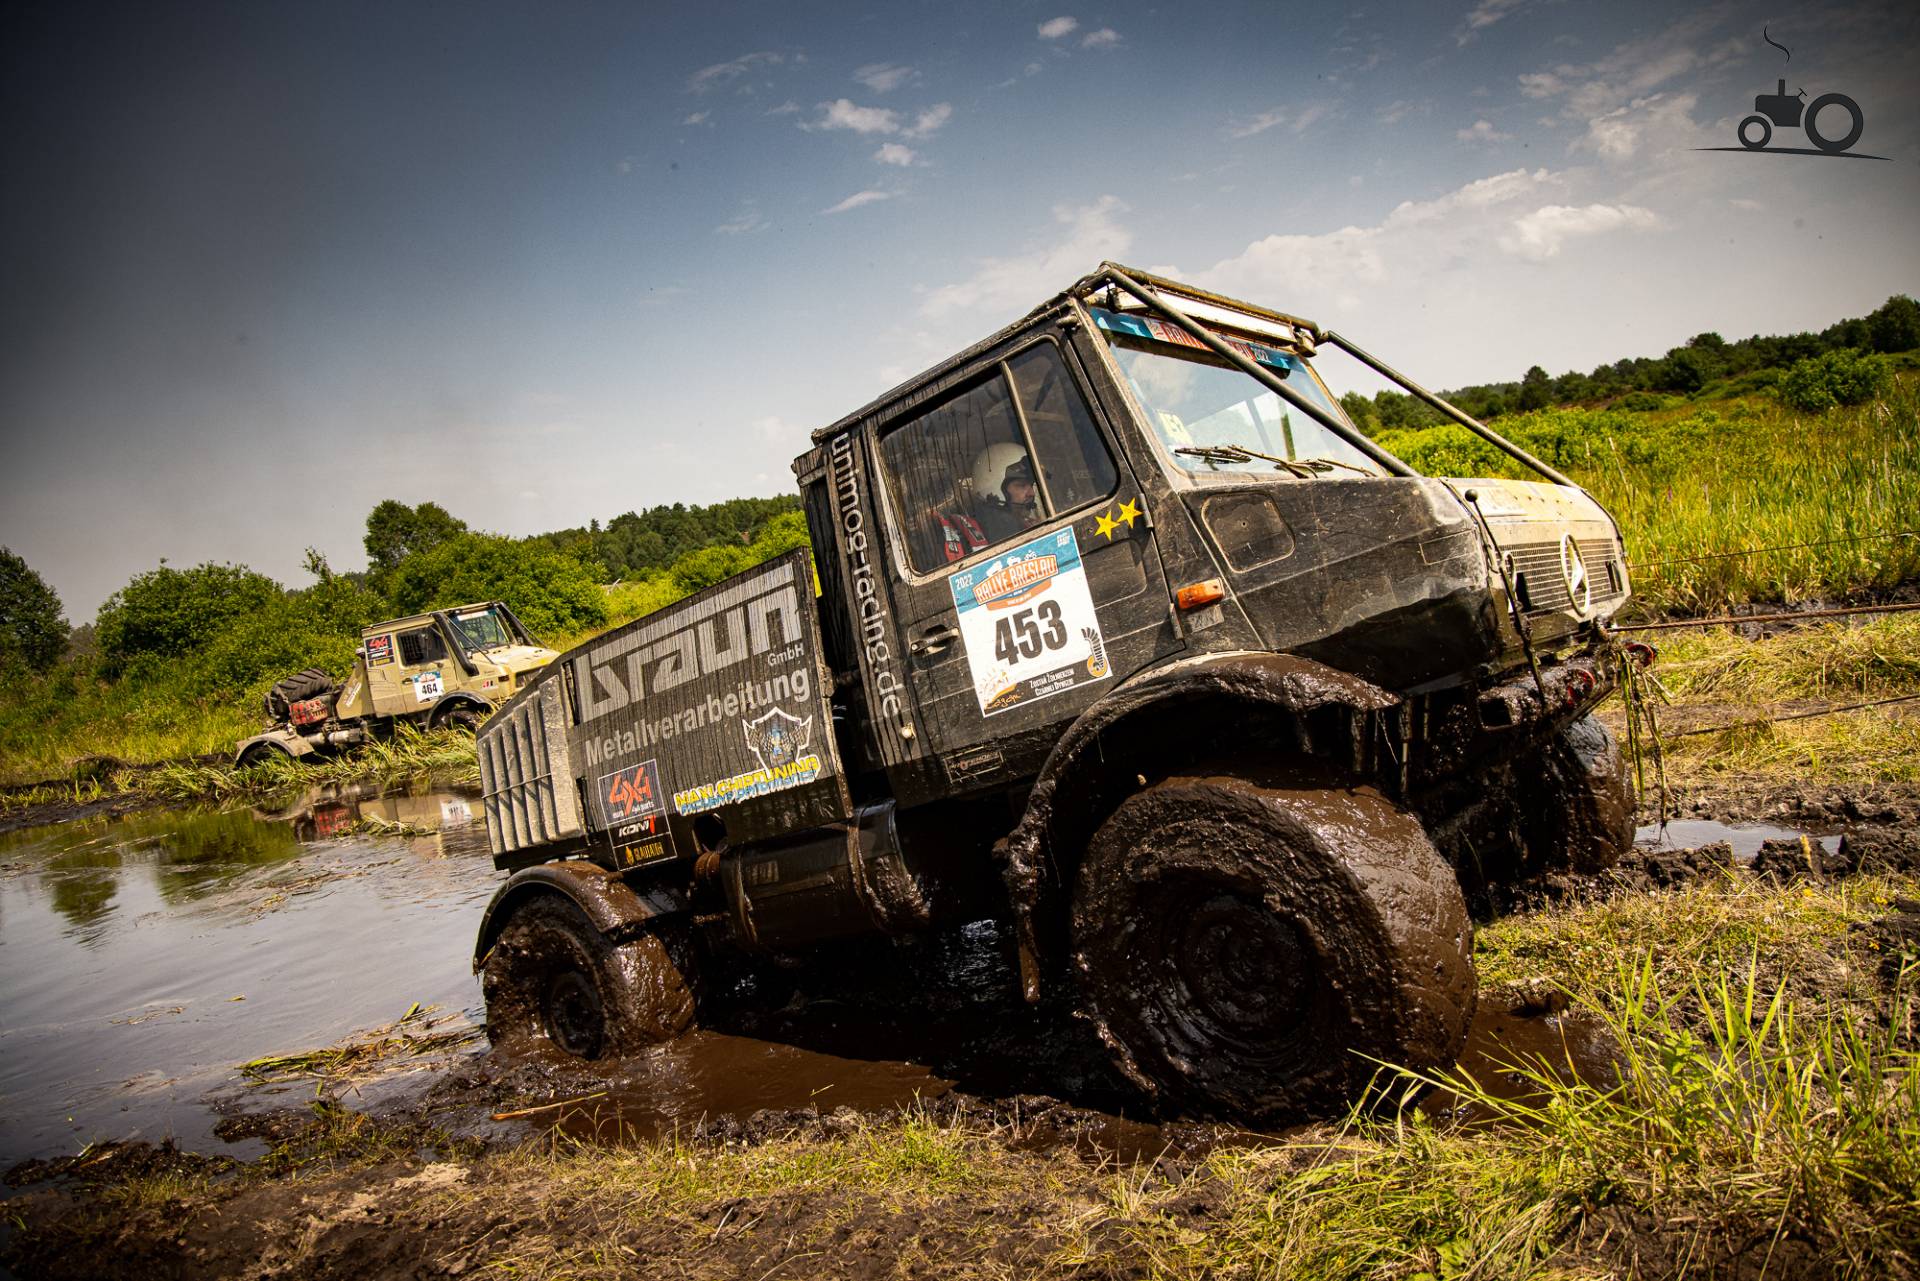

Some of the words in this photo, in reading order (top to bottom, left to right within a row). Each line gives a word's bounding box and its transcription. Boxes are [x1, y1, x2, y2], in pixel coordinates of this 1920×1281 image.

[831, 432, 903, 719] unimog-racing.de
[955, 574, 974, 590] 2022
[975, 571, 1011, 602] RALLYE
[1008, 557, 1056, 588] BRESLAU
[767, 642, 805, 668] GmbH
[995, 600, 1068, 665] 453
[422, 683, 438, 695] 464
[585, 667, 811, 767] Metallverarbeitung
[675, 785, 714, 807] MAXI
[716, 756, 819, 796] CHIPTUNING
